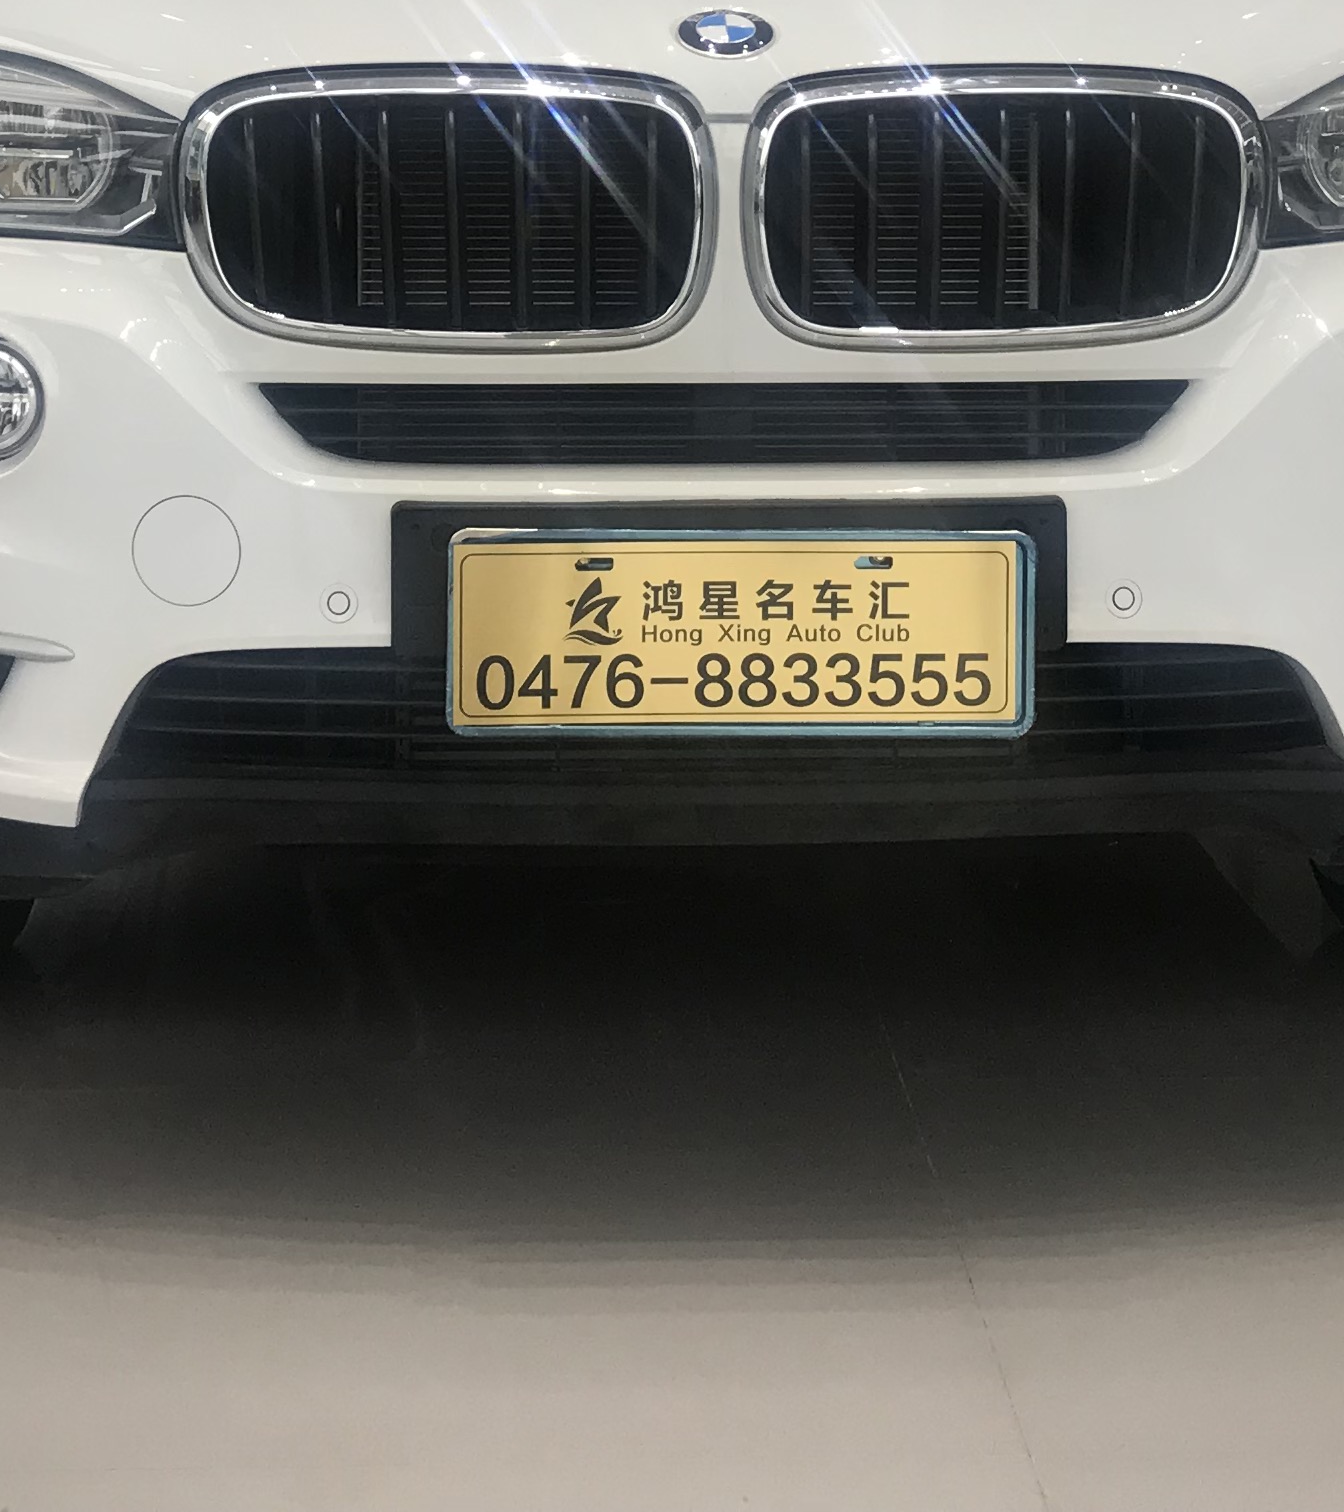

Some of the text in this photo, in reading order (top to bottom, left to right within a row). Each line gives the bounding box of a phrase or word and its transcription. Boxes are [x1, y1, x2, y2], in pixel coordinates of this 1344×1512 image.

[641, 579, 910, 621] 鸿星名车汇
[641, 623, 910, 646] Hong Xing Auto Club
[475, 652, 991, 710] 0476-8833555
